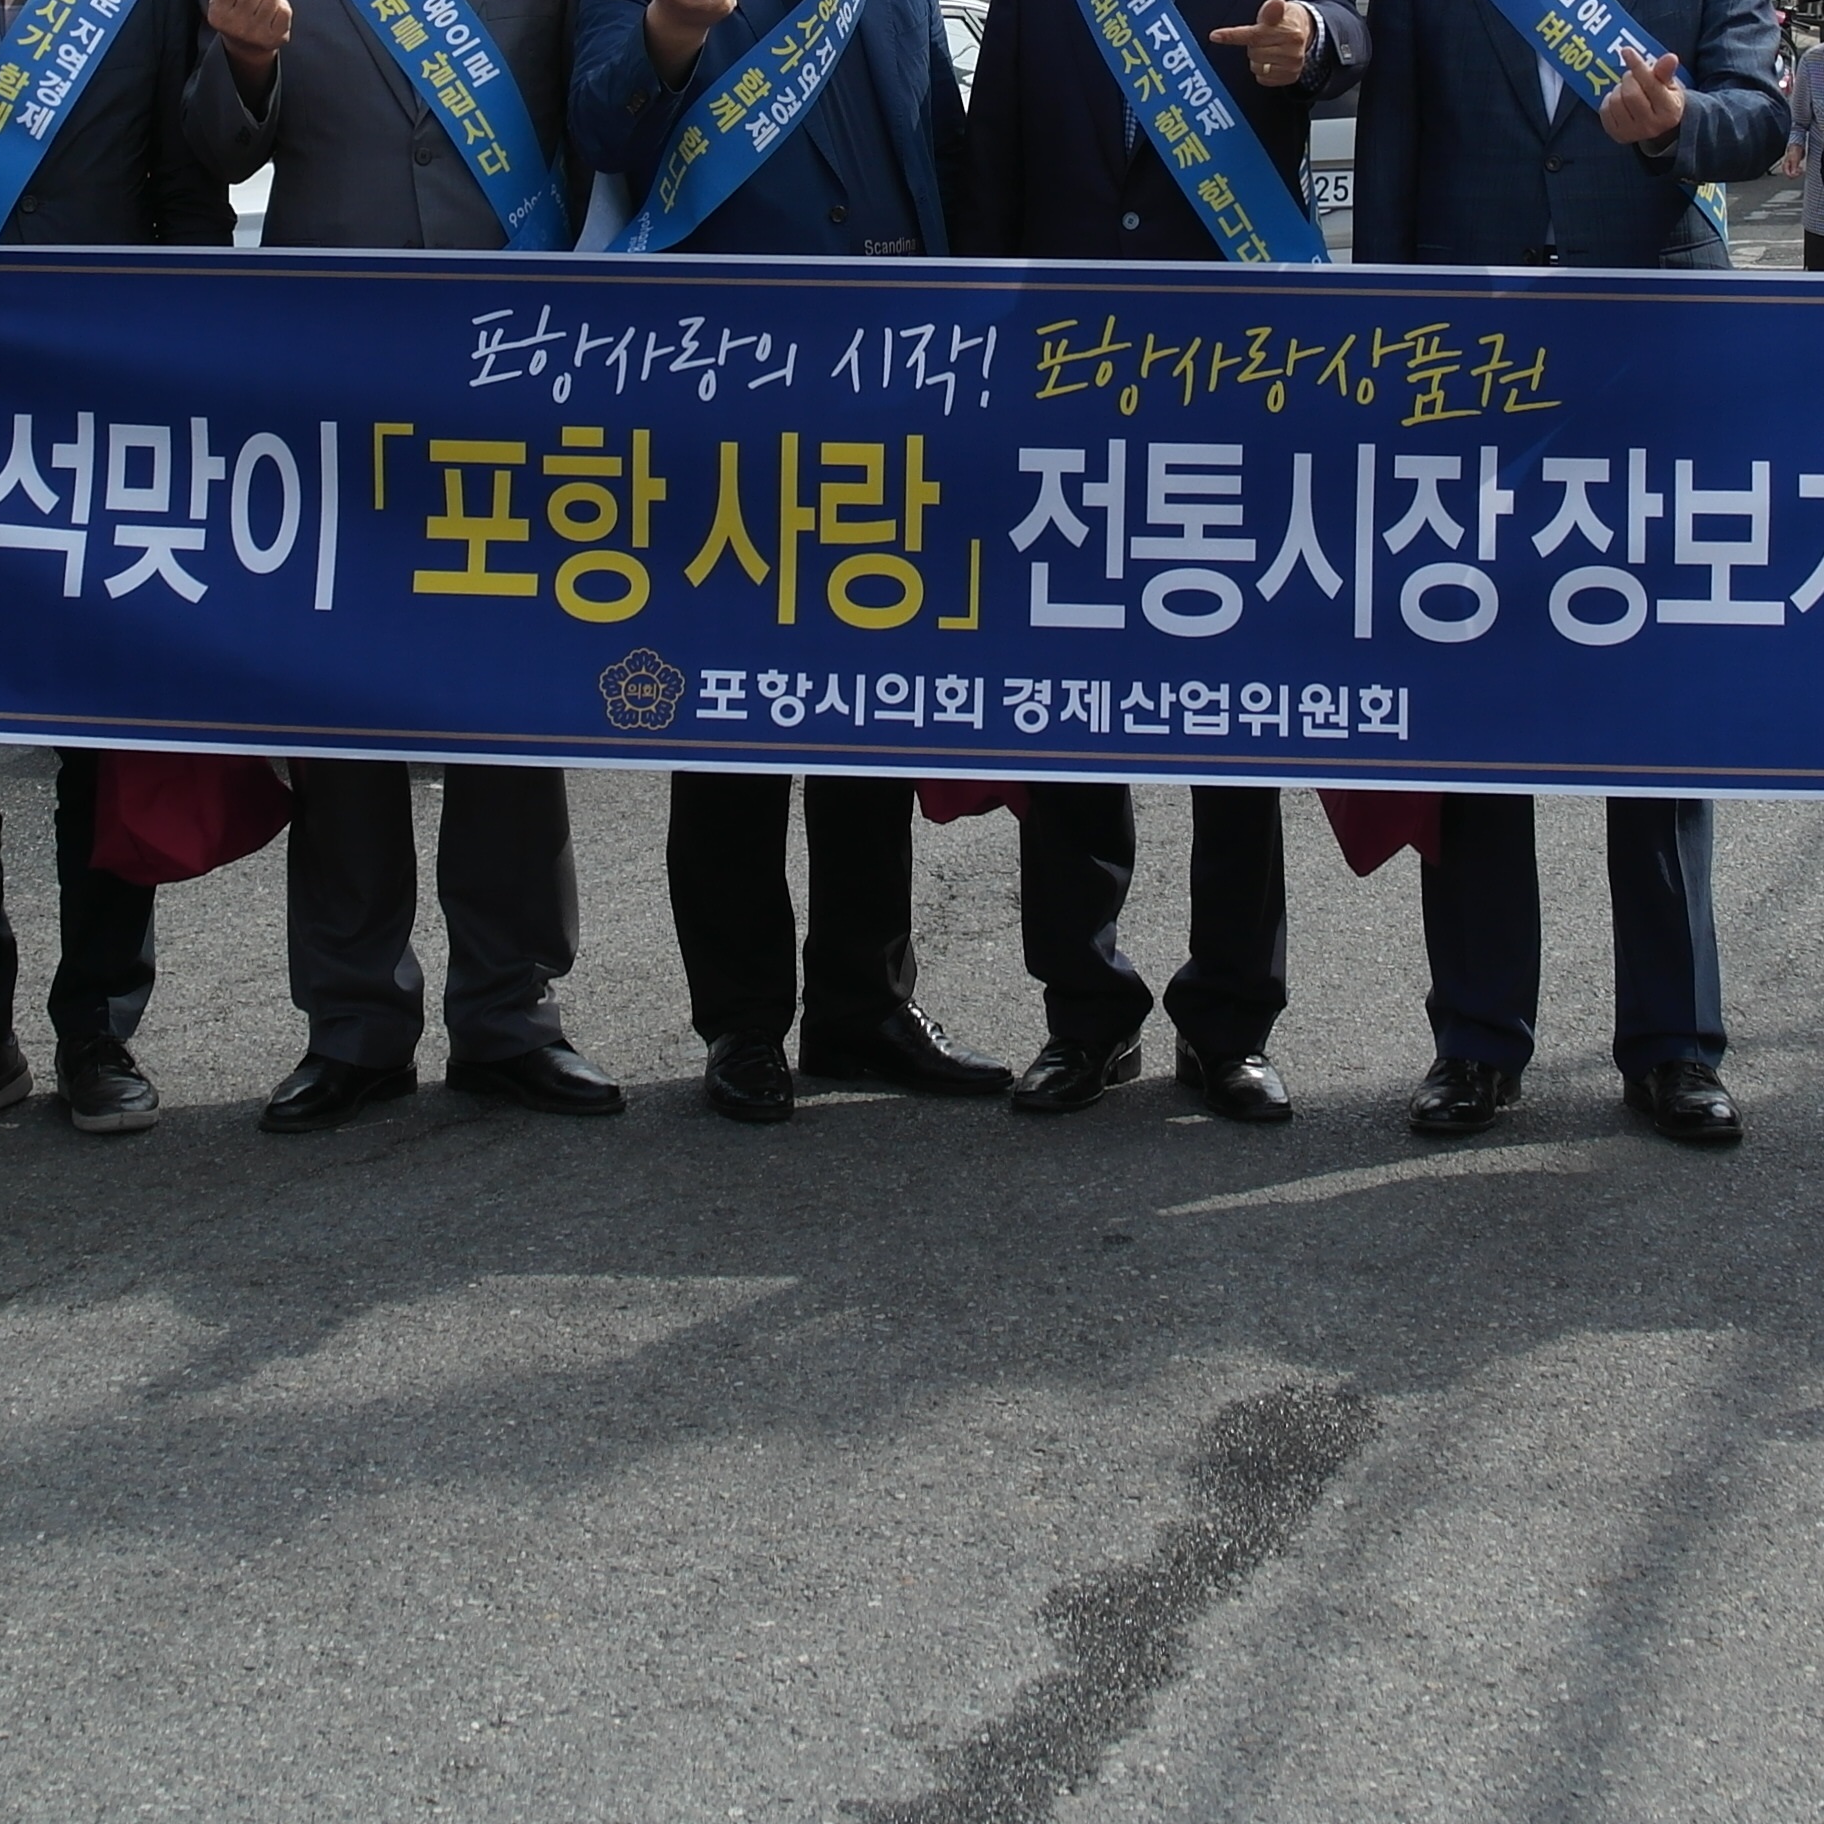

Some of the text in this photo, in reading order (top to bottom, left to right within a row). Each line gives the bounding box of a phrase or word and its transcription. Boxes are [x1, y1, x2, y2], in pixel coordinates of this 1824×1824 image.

[14, 16, 101, 142] 지역경제
[708, 66, 768, 133] 함께
[748, 40, 839, 154] 지역경제
[1143, 20, 1237, 137] 지역경제
[1535, 9, 1622, 102] 포항시
[418, 56, 512, 178] 살립시다
[1153, 104, 1210, 171] 함께
[468, 306, 1564, 430] 포항사랑의 시작! 포항사랑상품권
[1009, 438, 1505, 645] 전통시장
[694, 666, 985, 729] 포항시의회
